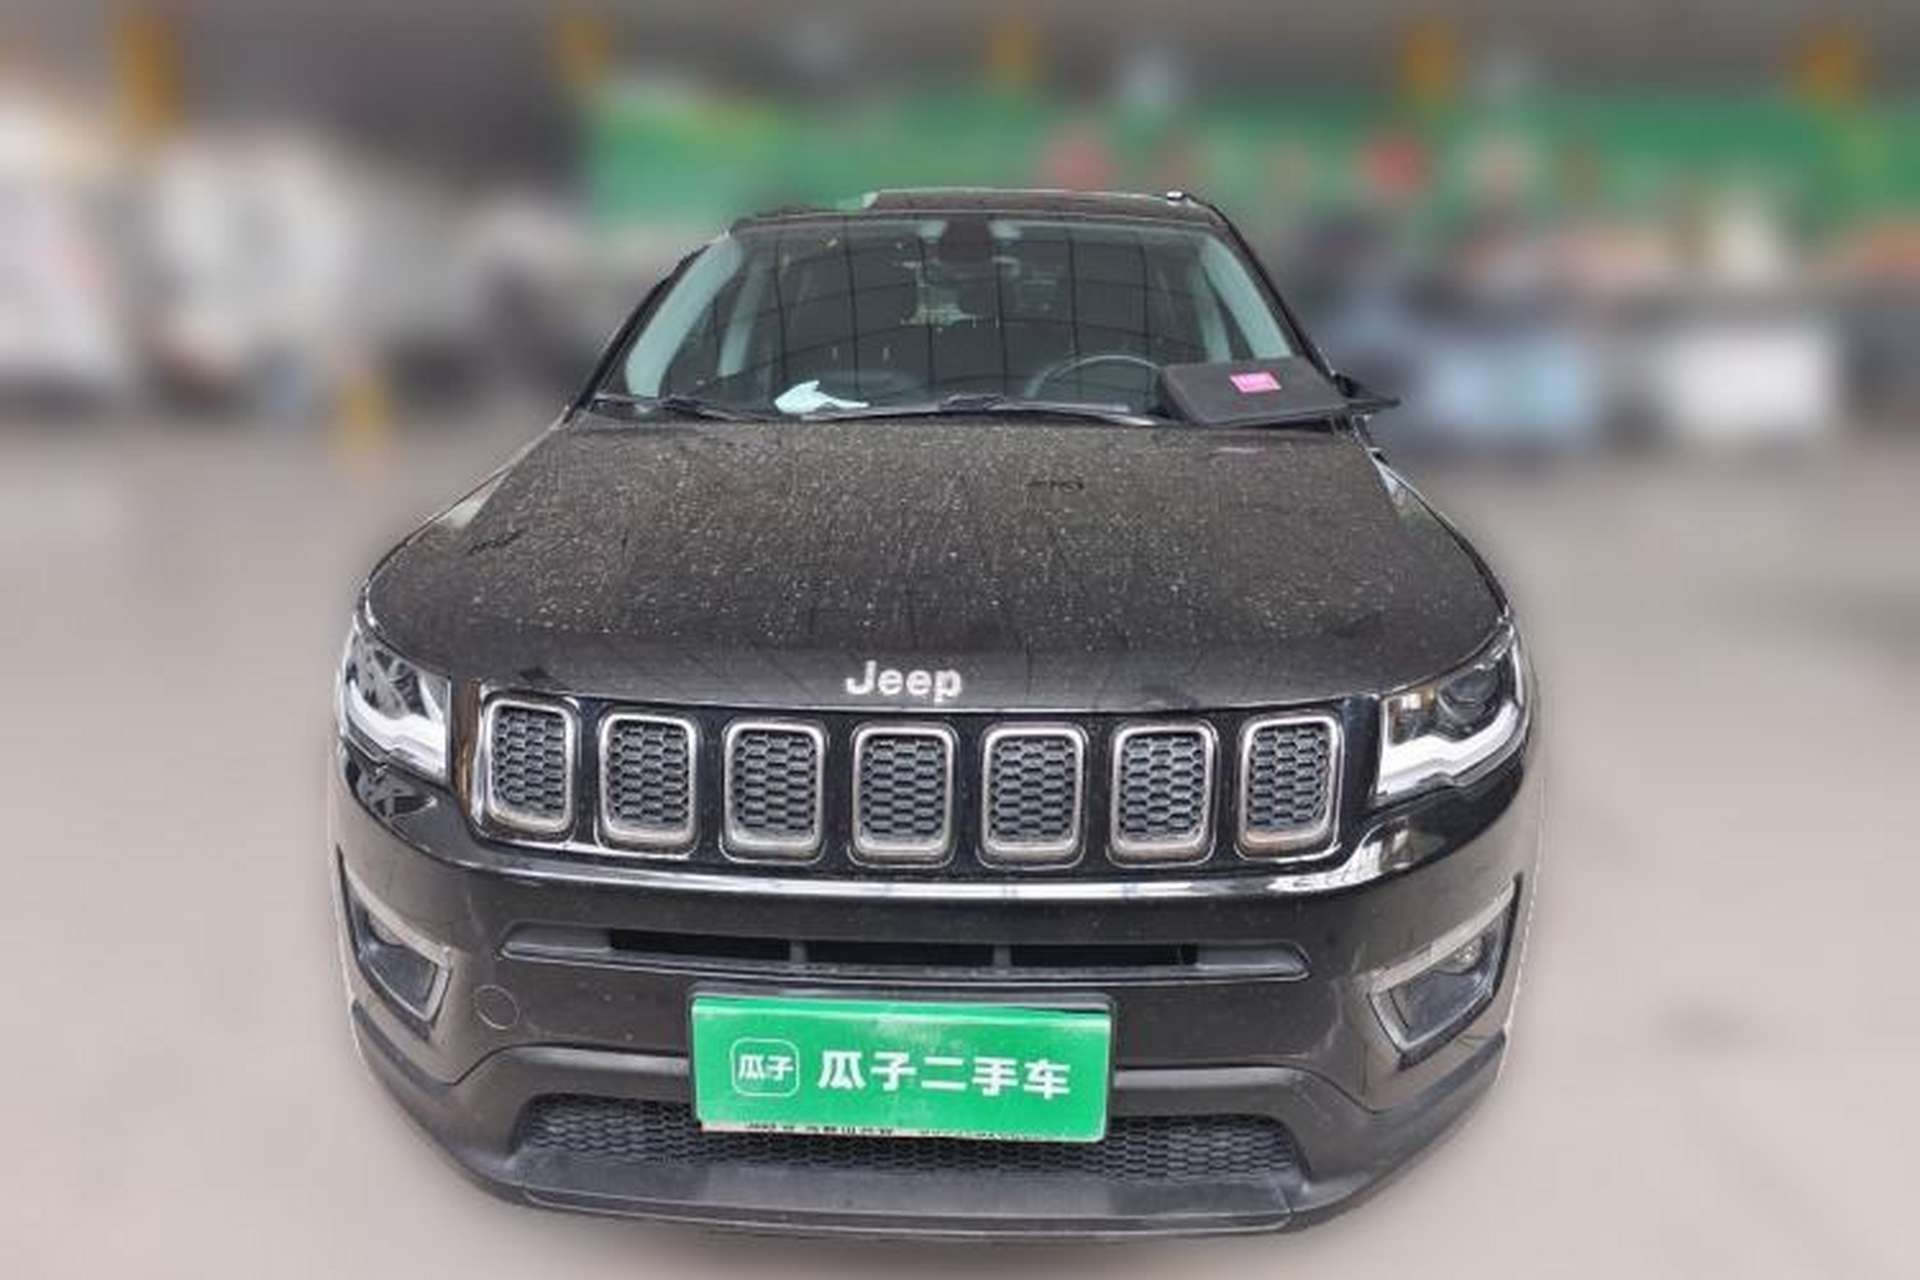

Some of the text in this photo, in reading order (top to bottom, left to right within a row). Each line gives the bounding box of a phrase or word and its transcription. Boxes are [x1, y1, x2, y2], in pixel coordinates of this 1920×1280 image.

[846, 660, 962, 703] Jeep
[737, 1053, 795, 1082] 瓜子
[817, 1049, 1071, 1100] 瓜子二手车
